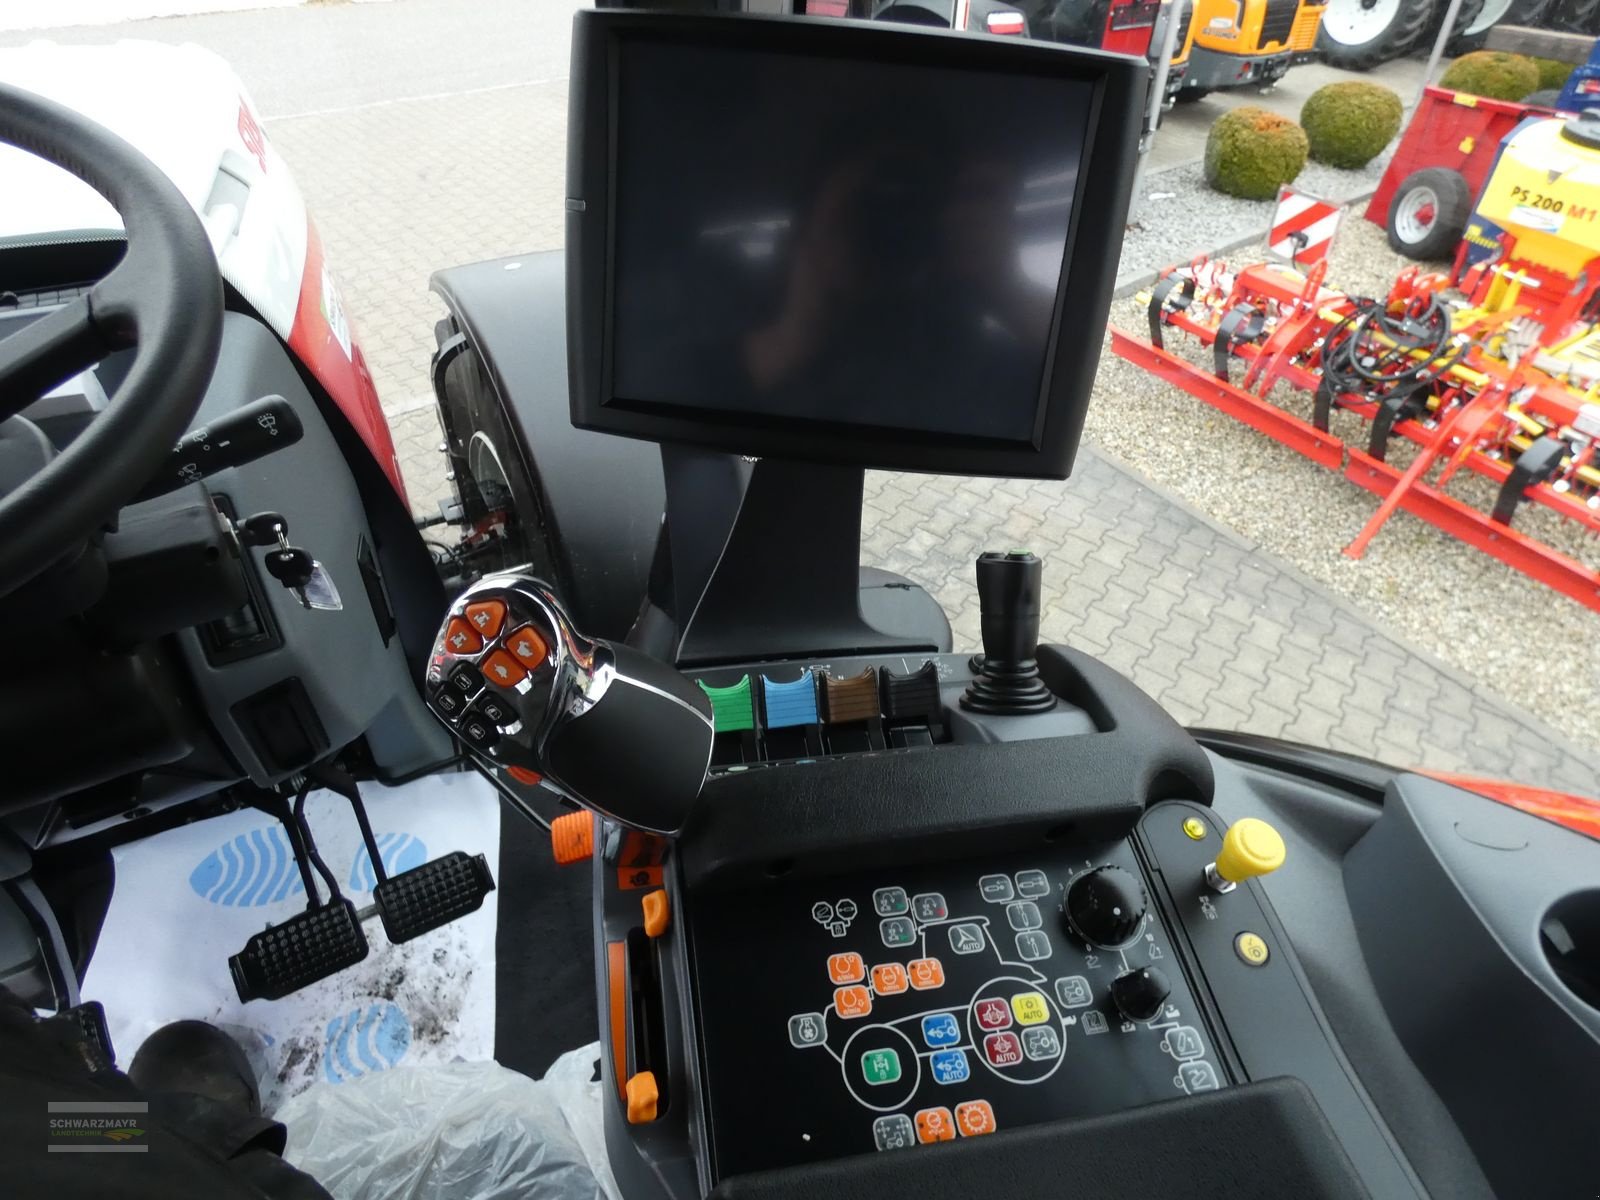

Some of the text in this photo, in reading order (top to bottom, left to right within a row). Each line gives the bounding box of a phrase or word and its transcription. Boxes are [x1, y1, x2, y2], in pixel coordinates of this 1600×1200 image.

[1510, 185, 1530, 202] PS
[1532, 194, 1564, 213] 200
[1567, 204, 1598, 222] M1
[962, 942, 982, 952] AUTO
[930, 960, 937, 971] 2
[1023, 1010, 1043, 1020] AUTO
[995, 1052, 1017, 1064] AUTO
[942, 1069, 964, 1082] AUTO
